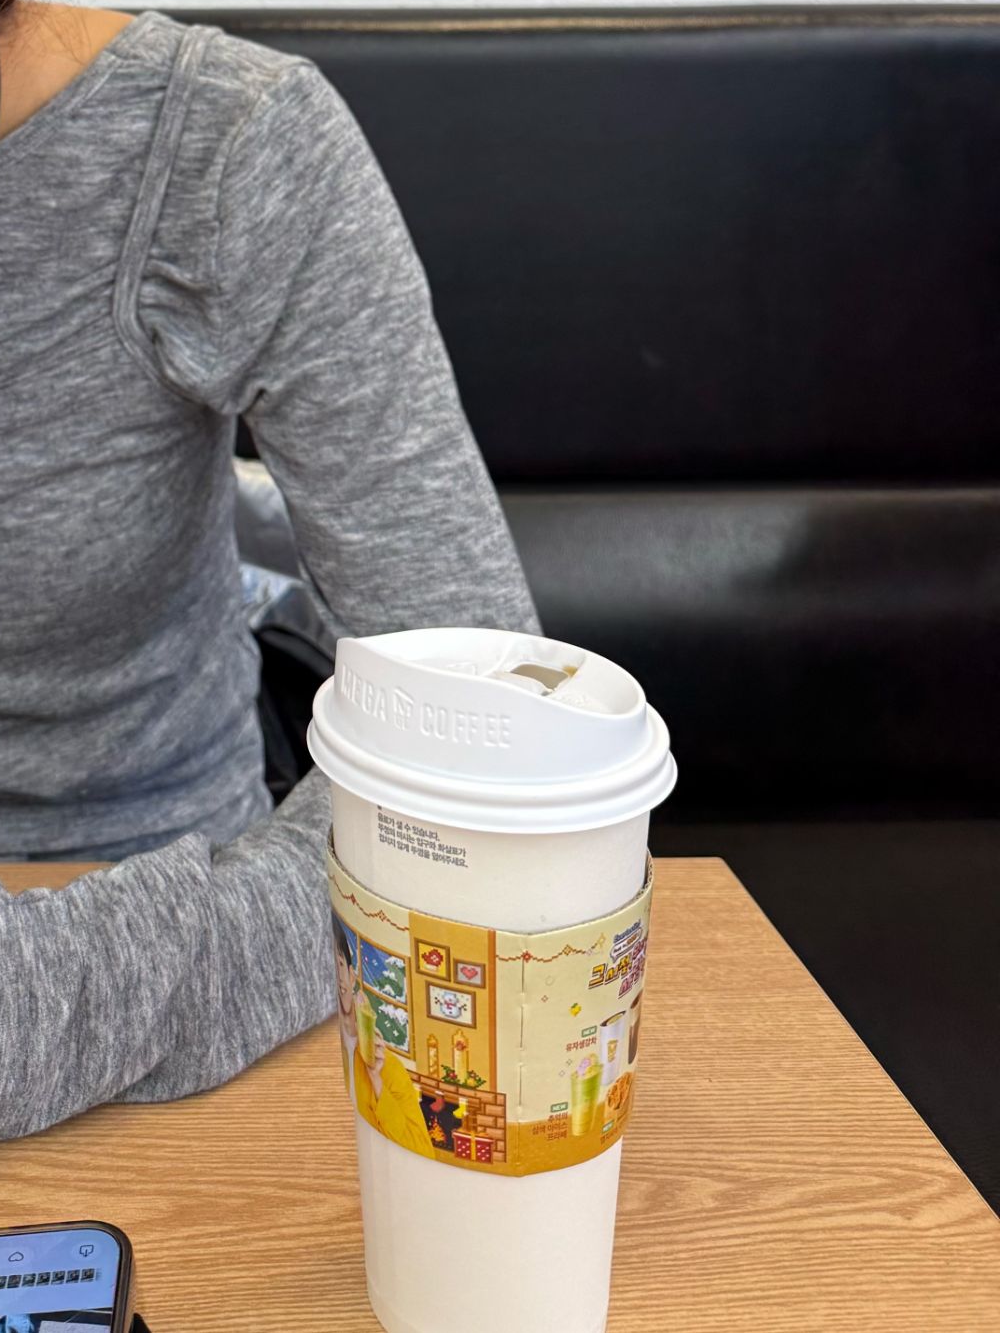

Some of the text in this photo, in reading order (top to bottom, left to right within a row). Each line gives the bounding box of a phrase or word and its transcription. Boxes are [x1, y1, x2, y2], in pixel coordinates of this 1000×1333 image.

[340, 664, 512, 748] MEGA COFFEE
[551, 1102, 568, 1112] NEW
